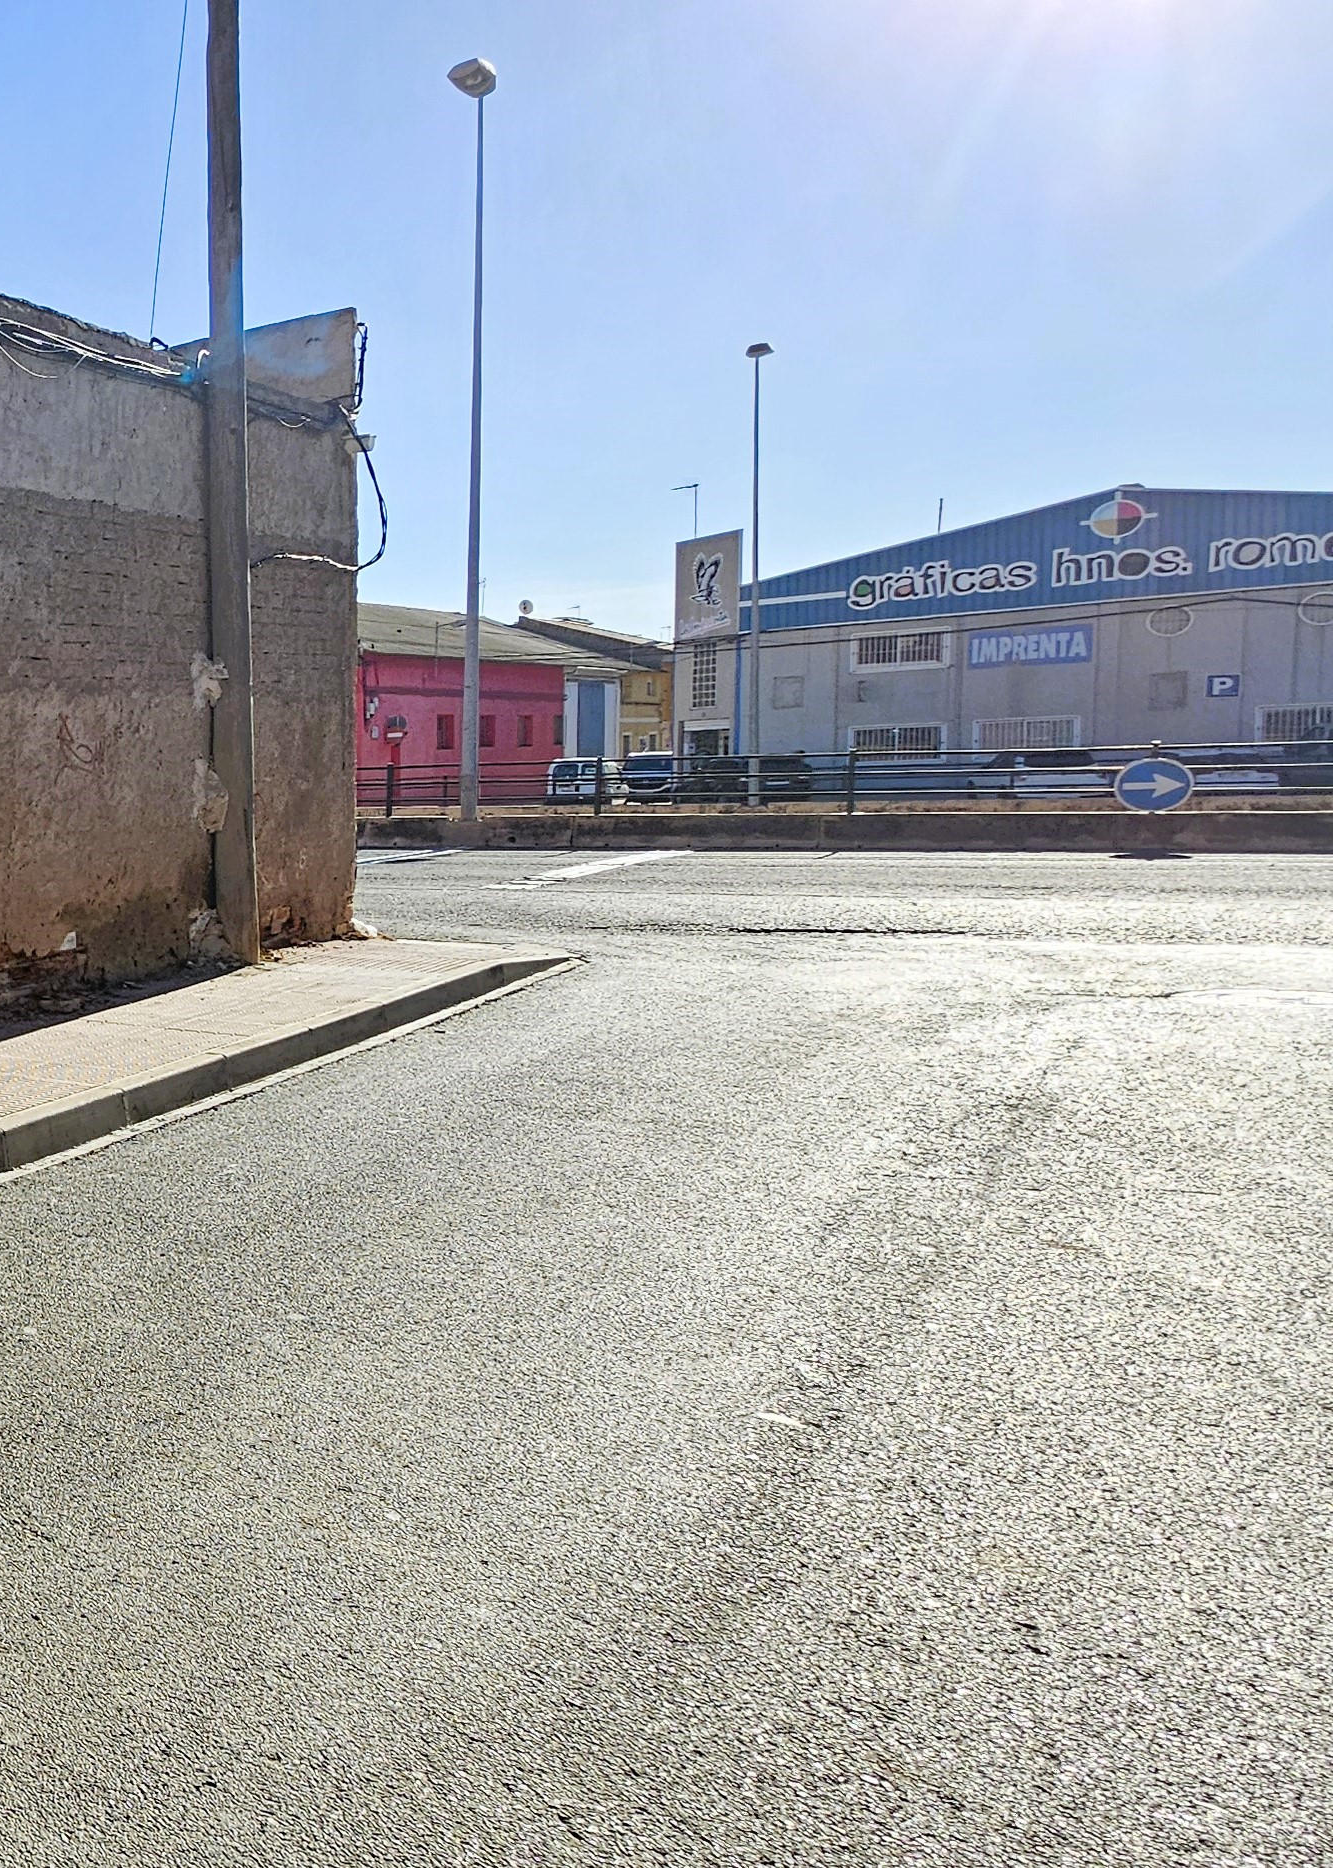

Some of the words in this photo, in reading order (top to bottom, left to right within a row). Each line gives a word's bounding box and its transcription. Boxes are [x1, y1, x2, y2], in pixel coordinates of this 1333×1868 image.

[848, 560, 1037, 610] gráficas
[1052, 548, 1192, 587] hnos.
[971, 631, 1087, 665] IMPRENTA
[1211, 676, 1234, 696] P
